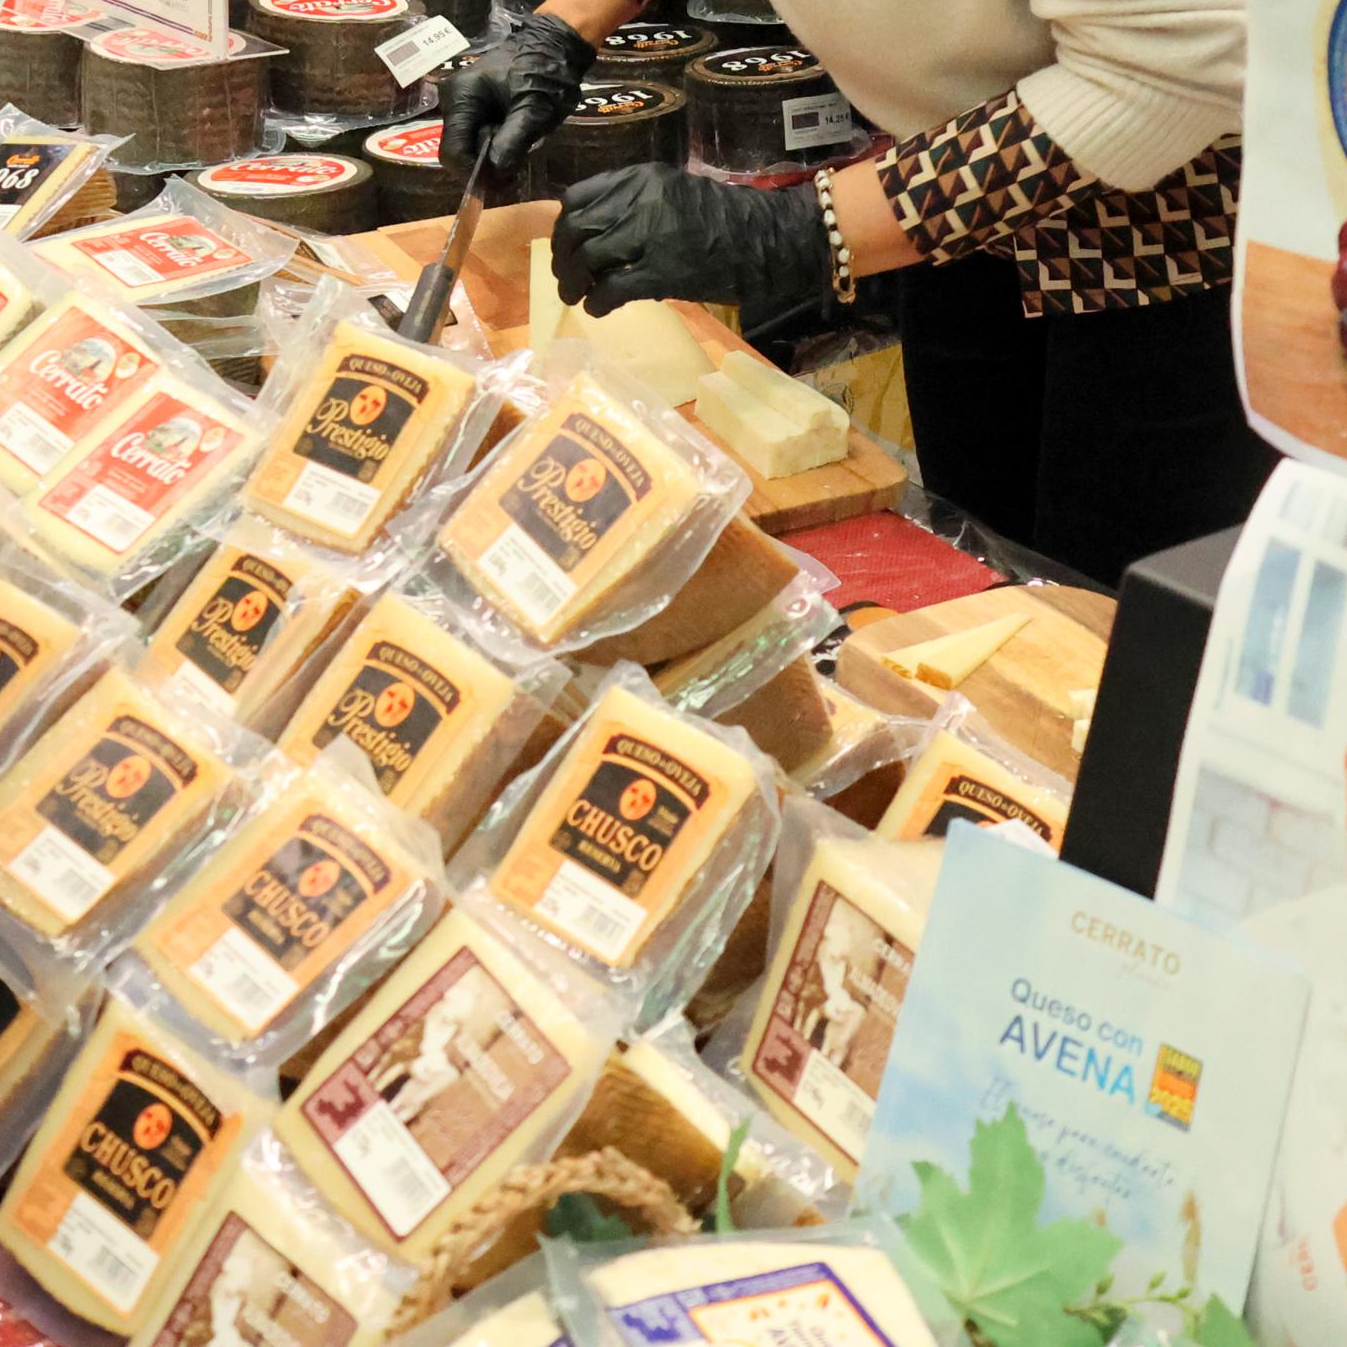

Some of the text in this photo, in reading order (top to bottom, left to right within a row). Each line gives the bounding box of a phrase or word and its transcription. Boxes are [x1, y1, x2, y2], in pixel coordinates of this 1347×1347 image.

[605, 30, 692, 46] 1968
[721, 50, 811, 71] 1968
[140, 232, 203, 267] Cerrato
[29, 349, 108, 410] Cerrato
[349, 358, 424, 395] QUESO OVEJA
[111, 432, 192, 485] Cerrato
[305, 397, 392, 461] Prestigio
[575, 418, 646, 488] QUESO OVEJA
[517, 456, 598, 550] Prestigio
[327, 688, 413, 772] Prestigio
[616, 738, 660, 764] QUESO
[958, 781, 1003, 808] QUESO
[566, 799, 664, 872] CHUSCO
[244, 870, 331, 948] CHUSCO
[1071, 909, 1182, 976] CERRATO
[1010, 977, 1144, 1057] Queso con
[999, 1013, 1137, 1106] AVENA
[81, 1122, 175, 1209] CHUSCO
